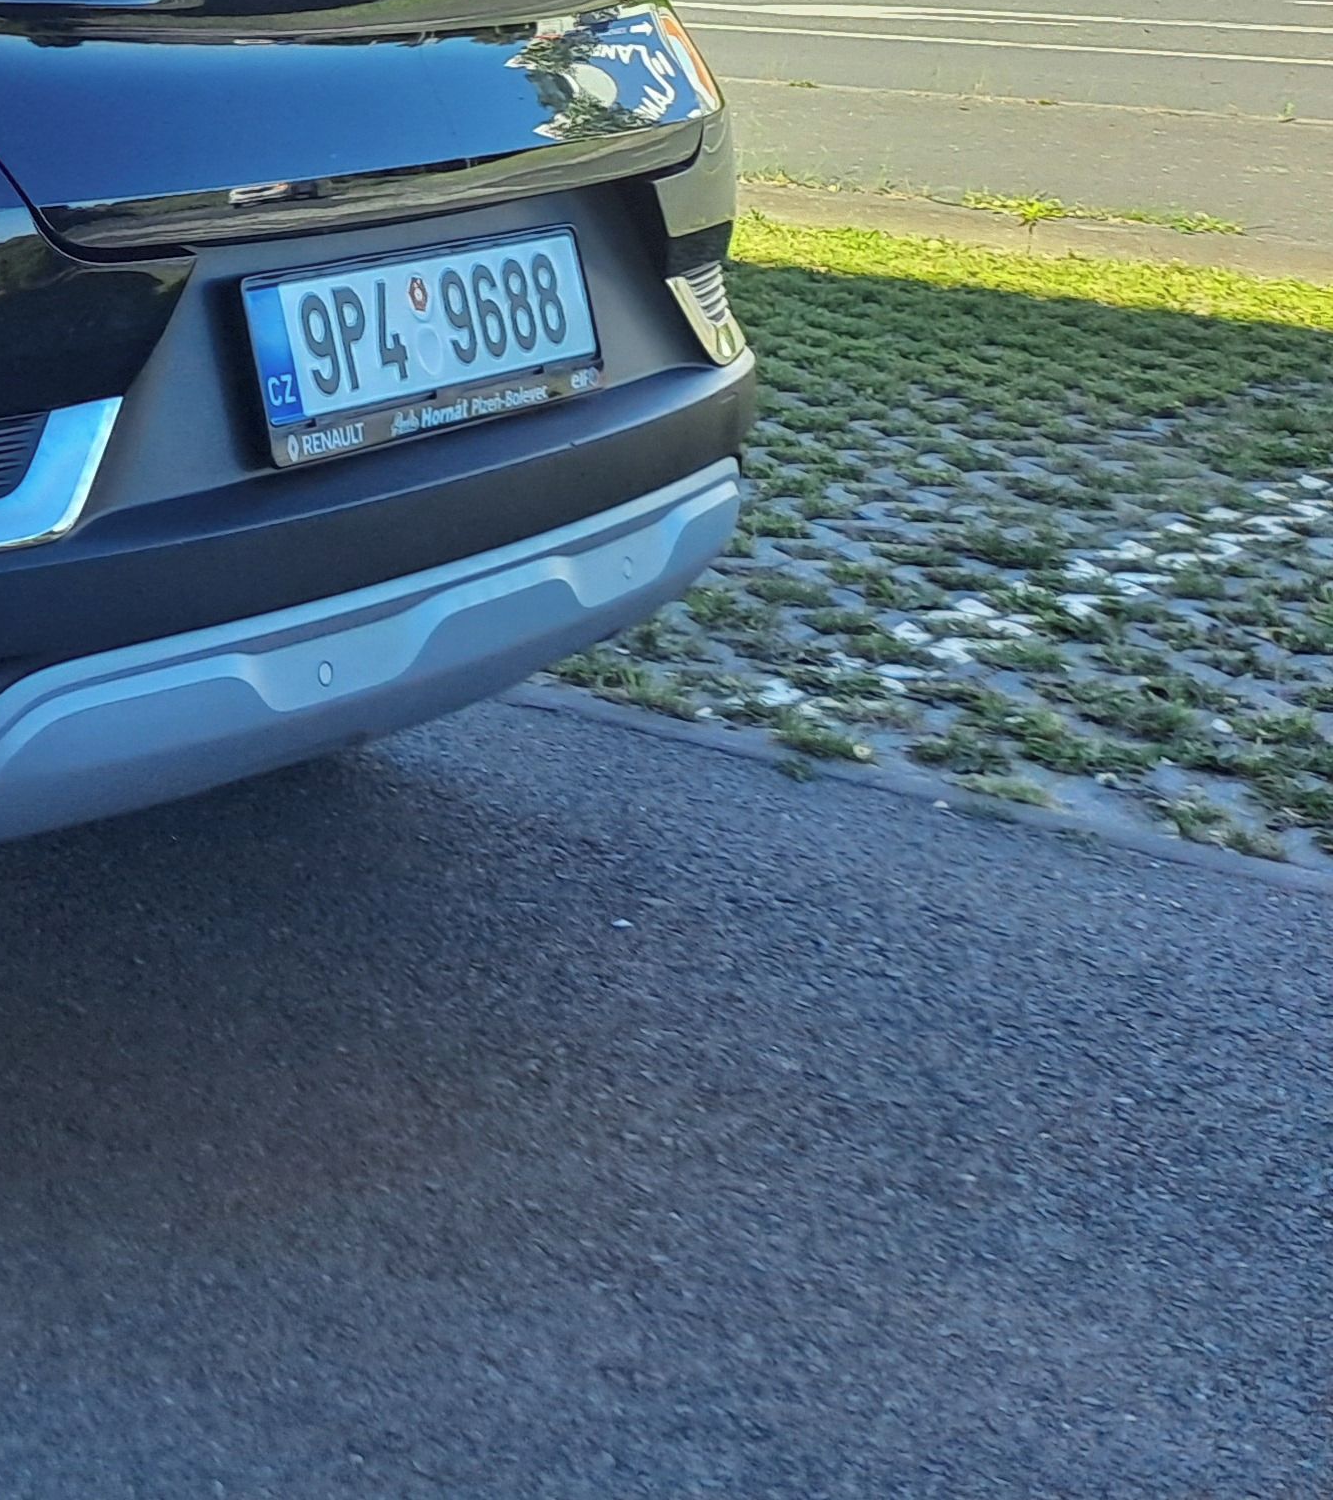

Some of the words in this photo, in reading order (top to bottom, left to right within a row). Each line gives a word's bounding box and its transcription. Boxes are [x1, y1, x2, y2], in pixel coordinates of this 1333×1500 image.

[300, 279, 409, 396] 9P4
[440, 253, 567, 365] 9688
[267, 373, 297, 407] CZ
[302, 422, 365, 456] RENAULT
